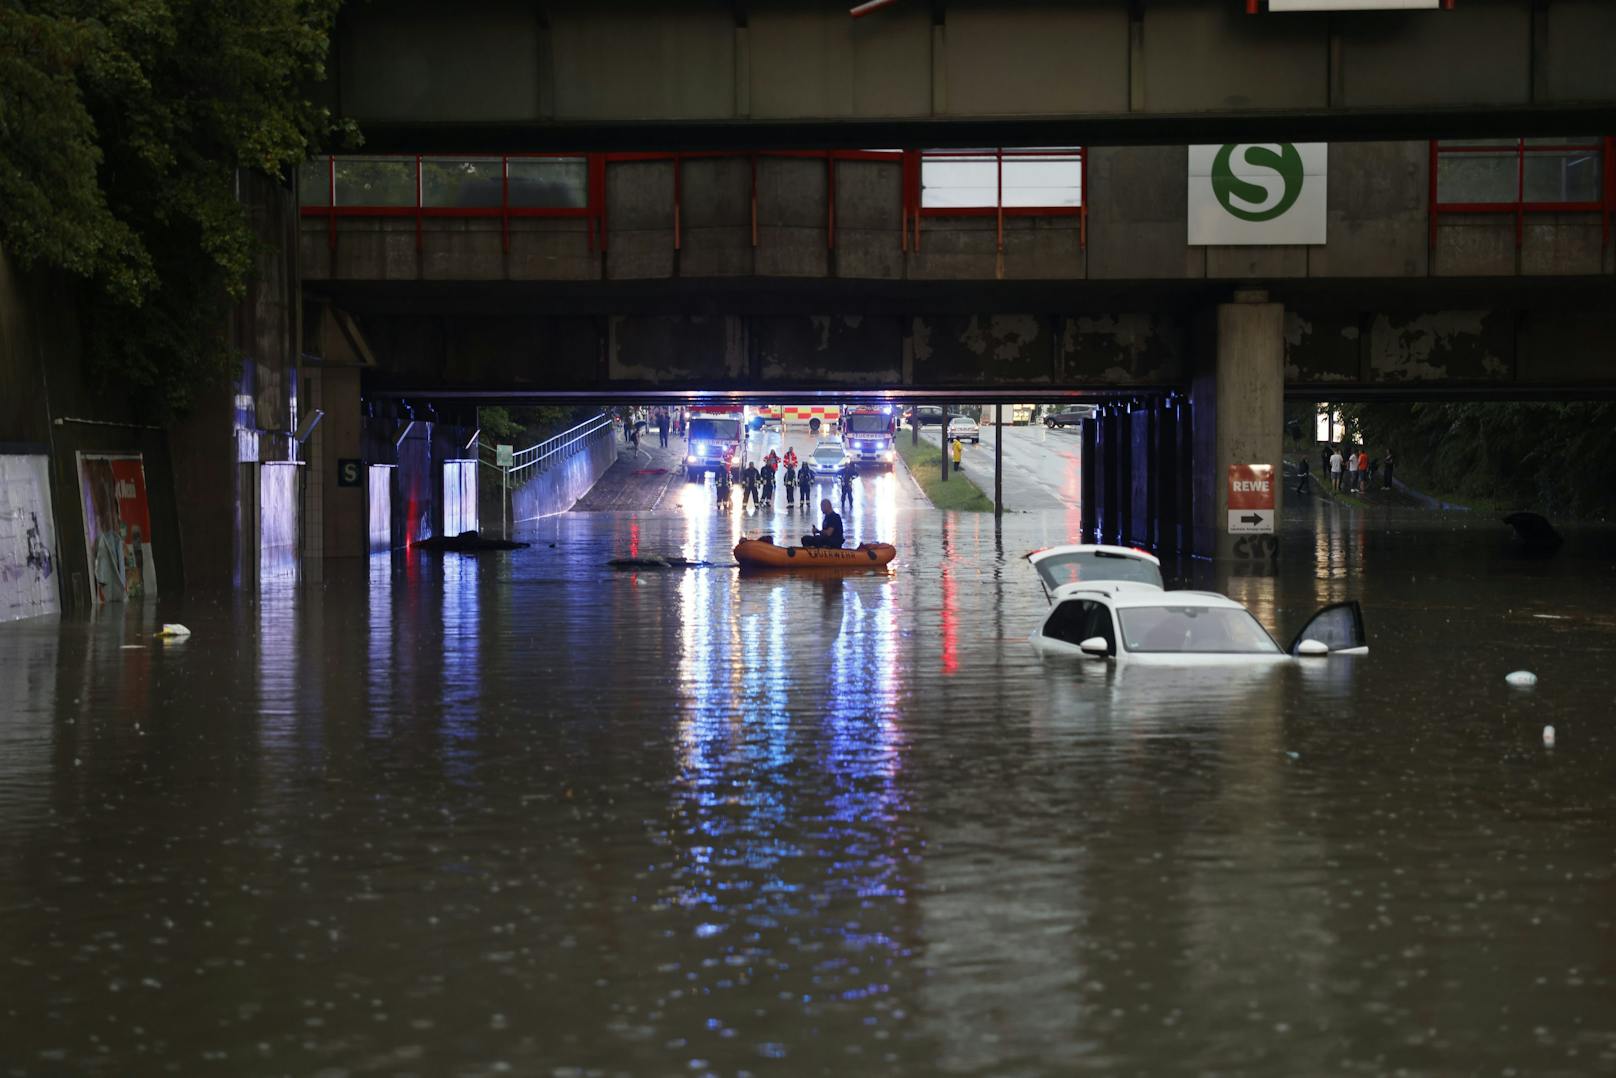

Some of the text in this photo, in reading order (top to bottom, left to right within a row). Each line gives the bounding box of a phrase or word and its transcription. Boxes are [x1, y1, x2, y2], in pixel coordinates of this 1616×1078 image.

[1229, 143, 1285, 214] S
[345, 463, 356, 481] S
[1232, 480, 1270, 492] REWE
[809, 549, 857, 560] UERWEHR
